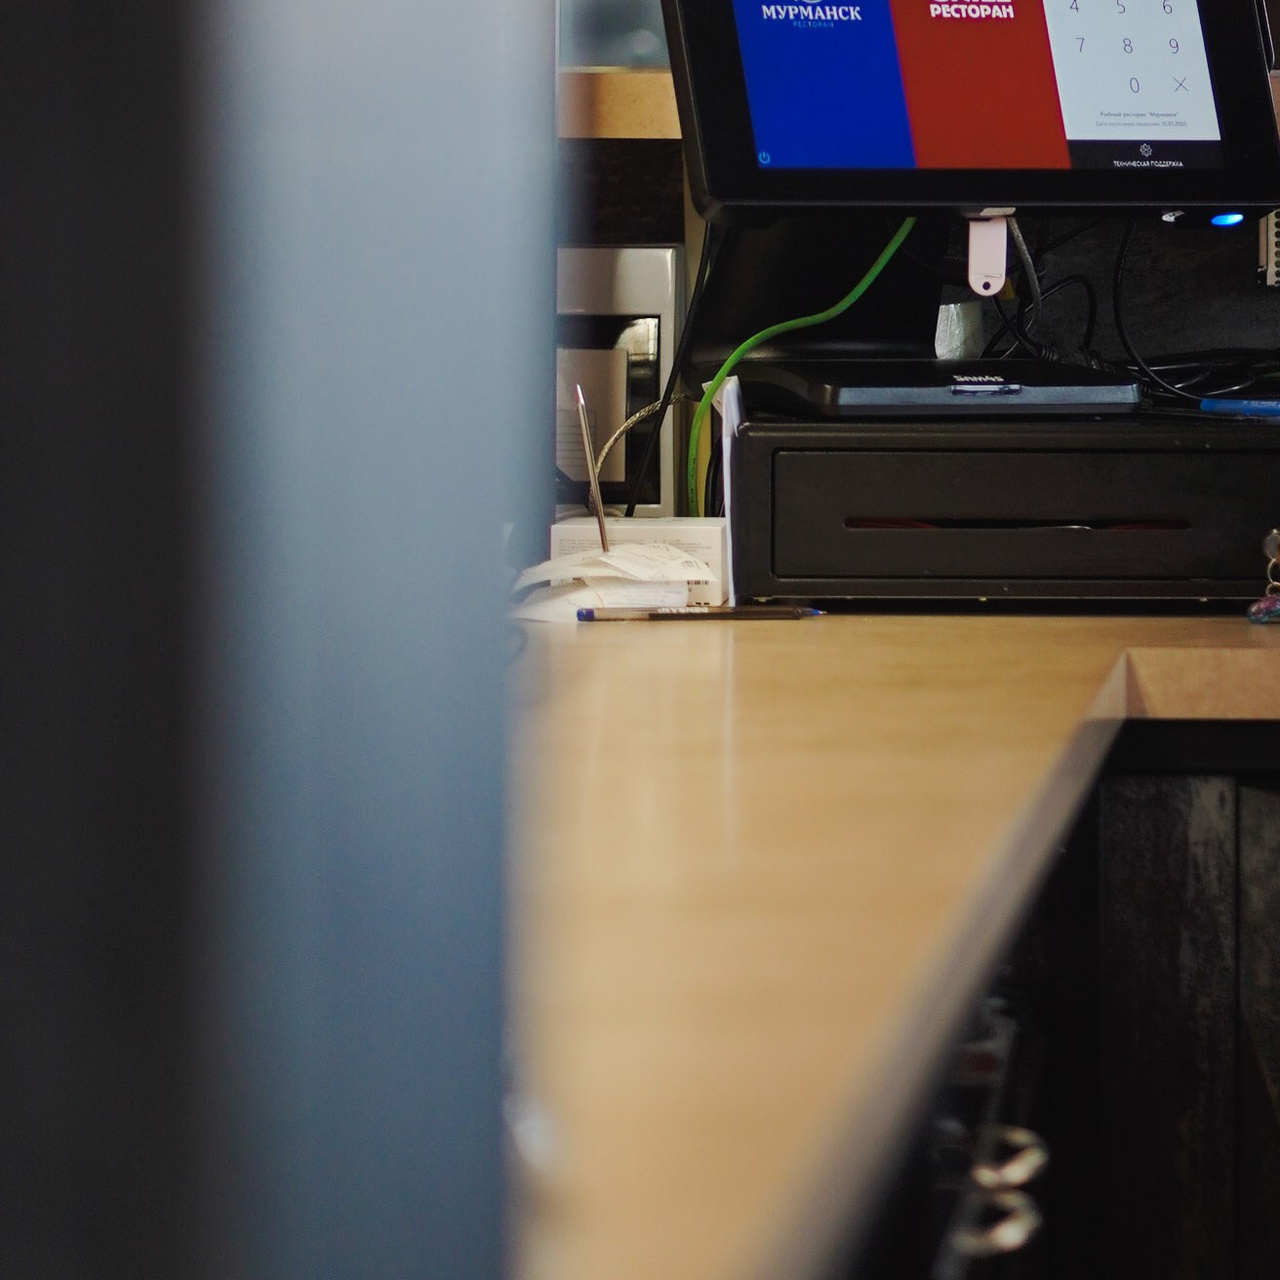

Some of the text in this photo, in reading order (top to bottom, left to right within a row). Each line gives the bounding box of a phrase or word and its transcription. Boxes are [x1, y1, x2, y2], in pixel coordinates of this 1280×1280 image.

[761, 4, 862, 21] МУРМАНСК
[929, 3, 1015, 19] РЕСТОРАН
[1075, 37, 1180, 55] 7 8 9
[1129, 77, 1140, 94] 0
